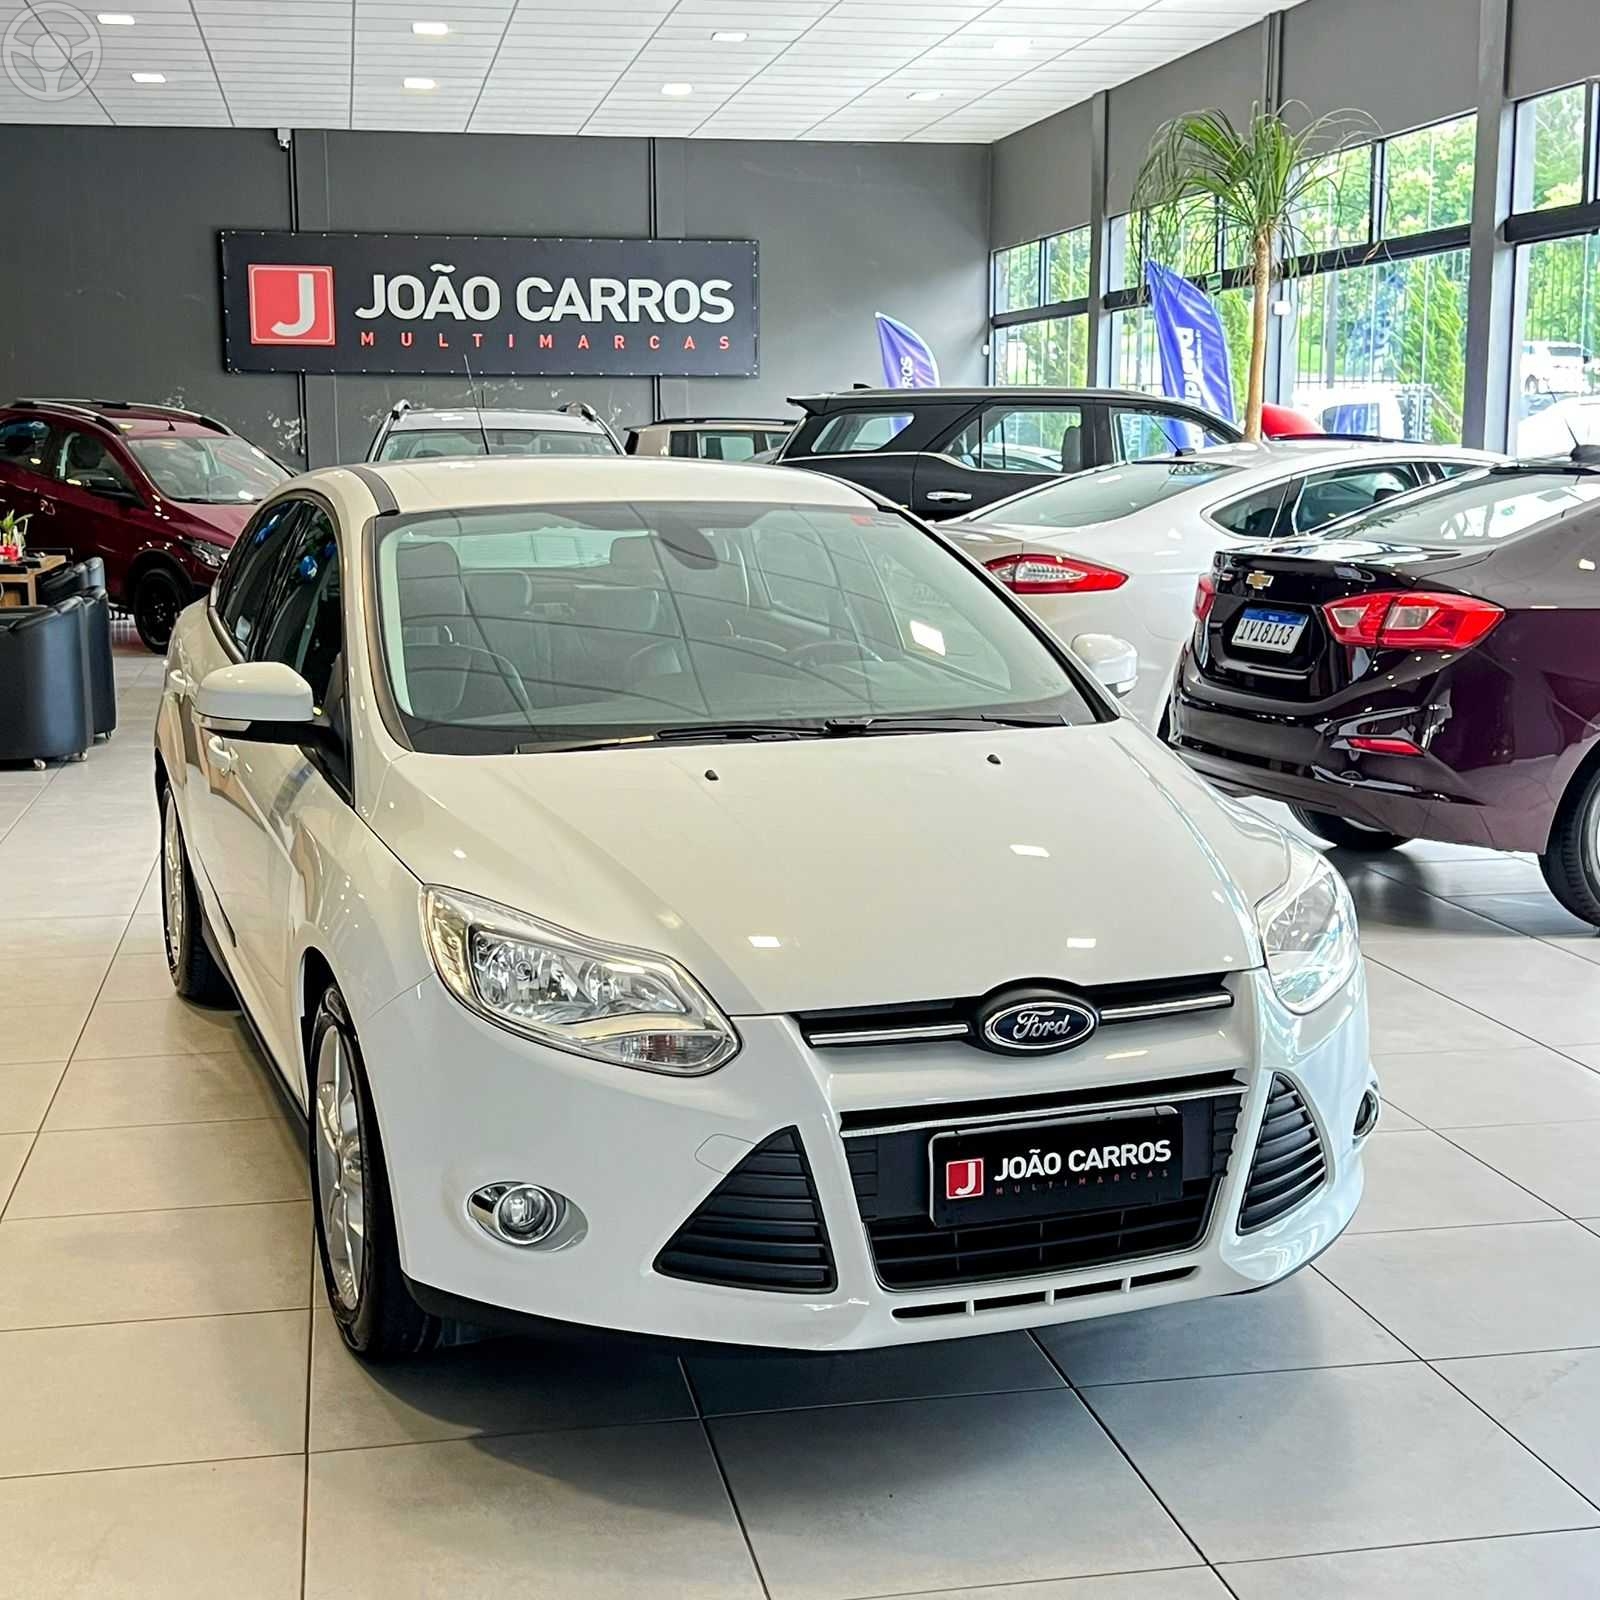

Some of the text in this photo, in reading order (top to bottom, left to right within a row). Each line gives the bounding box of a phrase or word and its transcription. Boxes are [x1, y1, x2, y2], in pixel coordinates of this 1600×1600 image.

[270, 272, 316, 337] J
[354, 263, 736, 323] JOÃO CARROS
[360, 331, 731, 350] MULTIMARCAS
[900, 355, 915, 389] ROS
[1012, 1009, 1071, 1040] Ford
[954, 1160, 977, 1196] J
[993, 1139, 1172, 1182] JOÃO CARROS
[996, 1168, 1169, 1195] MULTIMARCAS
